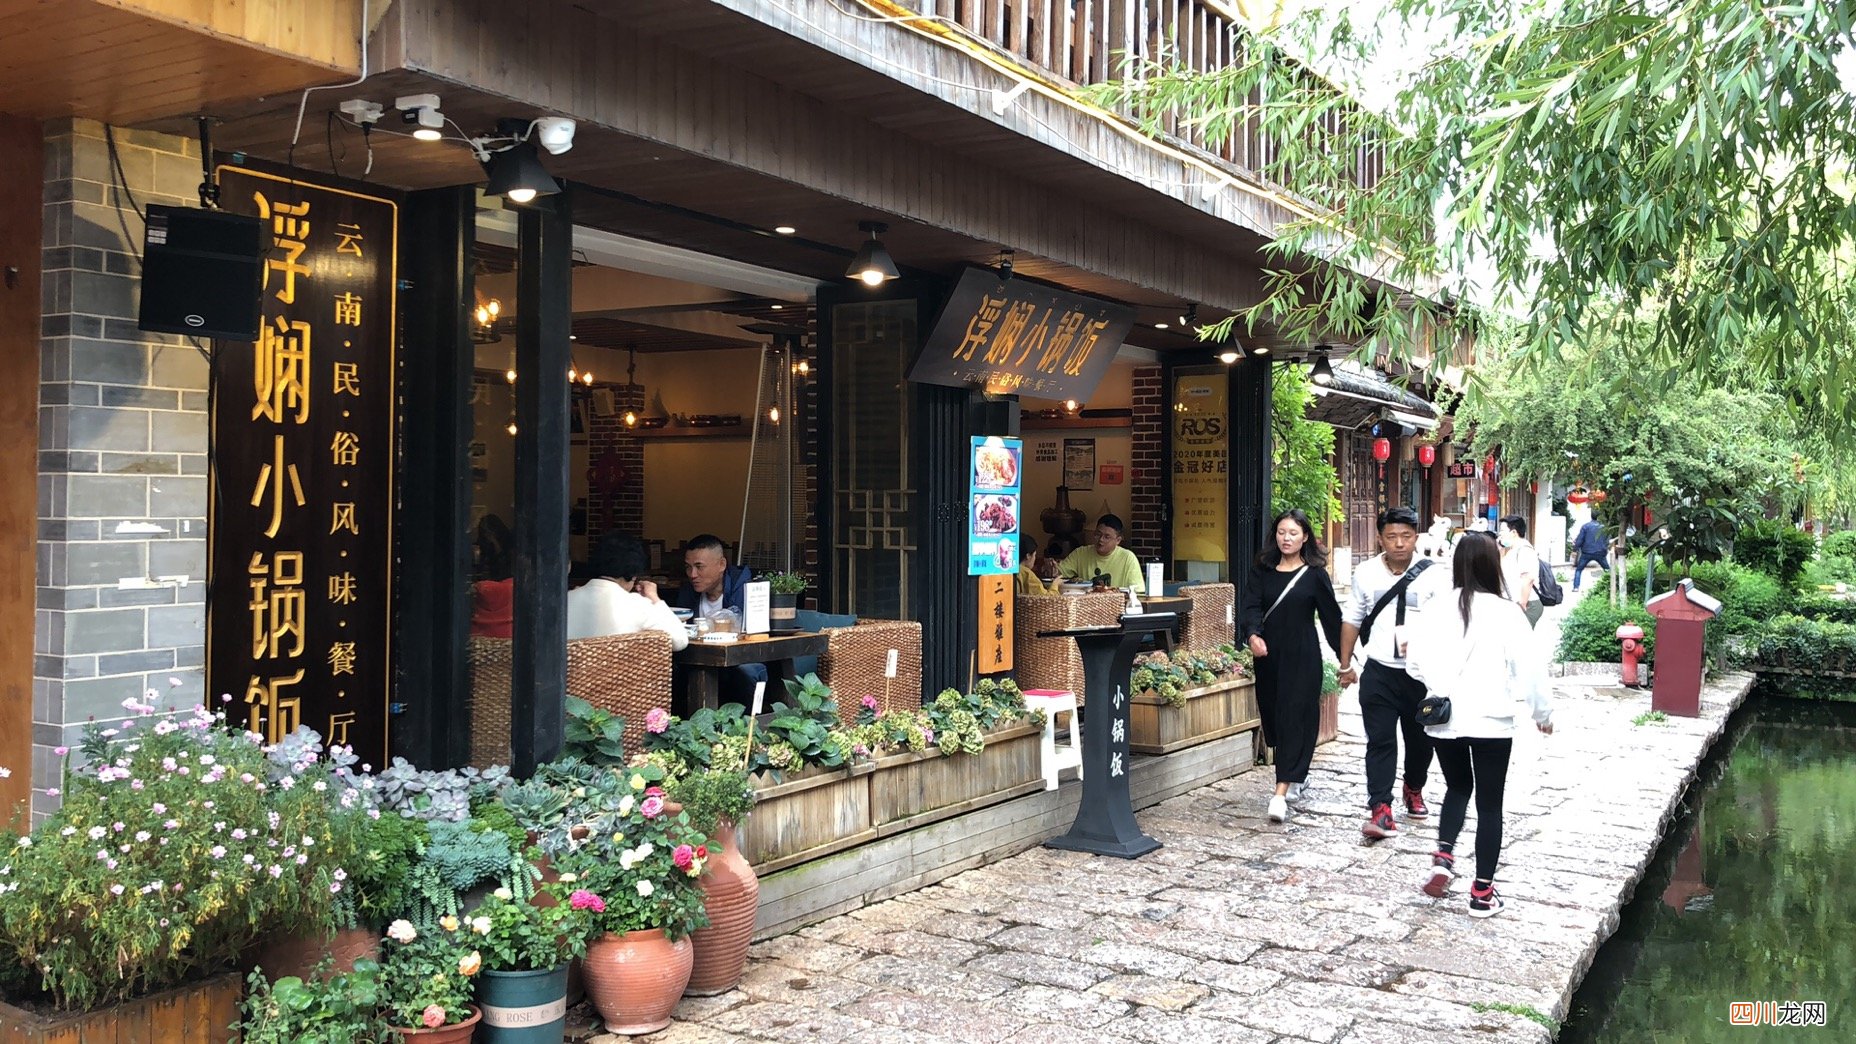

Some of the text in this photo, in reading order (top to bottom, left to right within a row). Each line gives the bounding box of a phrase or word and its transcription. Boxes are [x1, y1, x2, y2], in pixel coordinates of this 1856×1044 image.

[1173, 460, 1227, 474] 金冠好店
[1450, 462, 1474, 476] 超市
[1110, 684, 1126, 778] 小锅饭
[506, 1012, 533, 1023] ROSE
